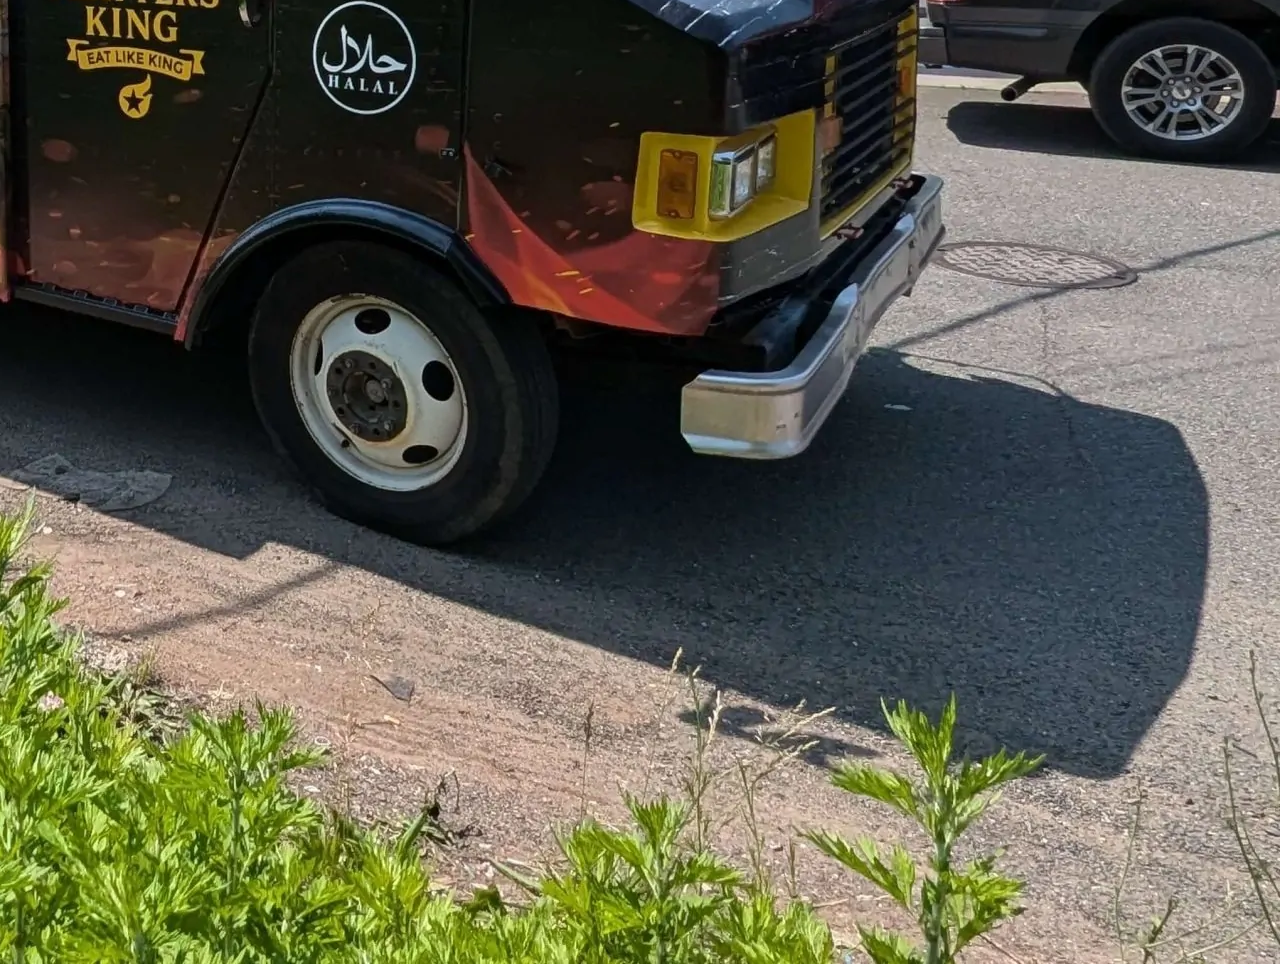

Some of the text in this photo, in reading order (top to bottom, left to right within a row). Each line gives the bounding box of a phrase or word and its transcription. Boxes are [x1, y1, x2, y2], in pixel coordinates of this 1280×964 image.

[85, 5, 178, 43] KING
[87, 50, 184, 74] EAT LIKE KING
[322, 24, 408, 74] حلال
[327, 74, 399, 95] HALAL
